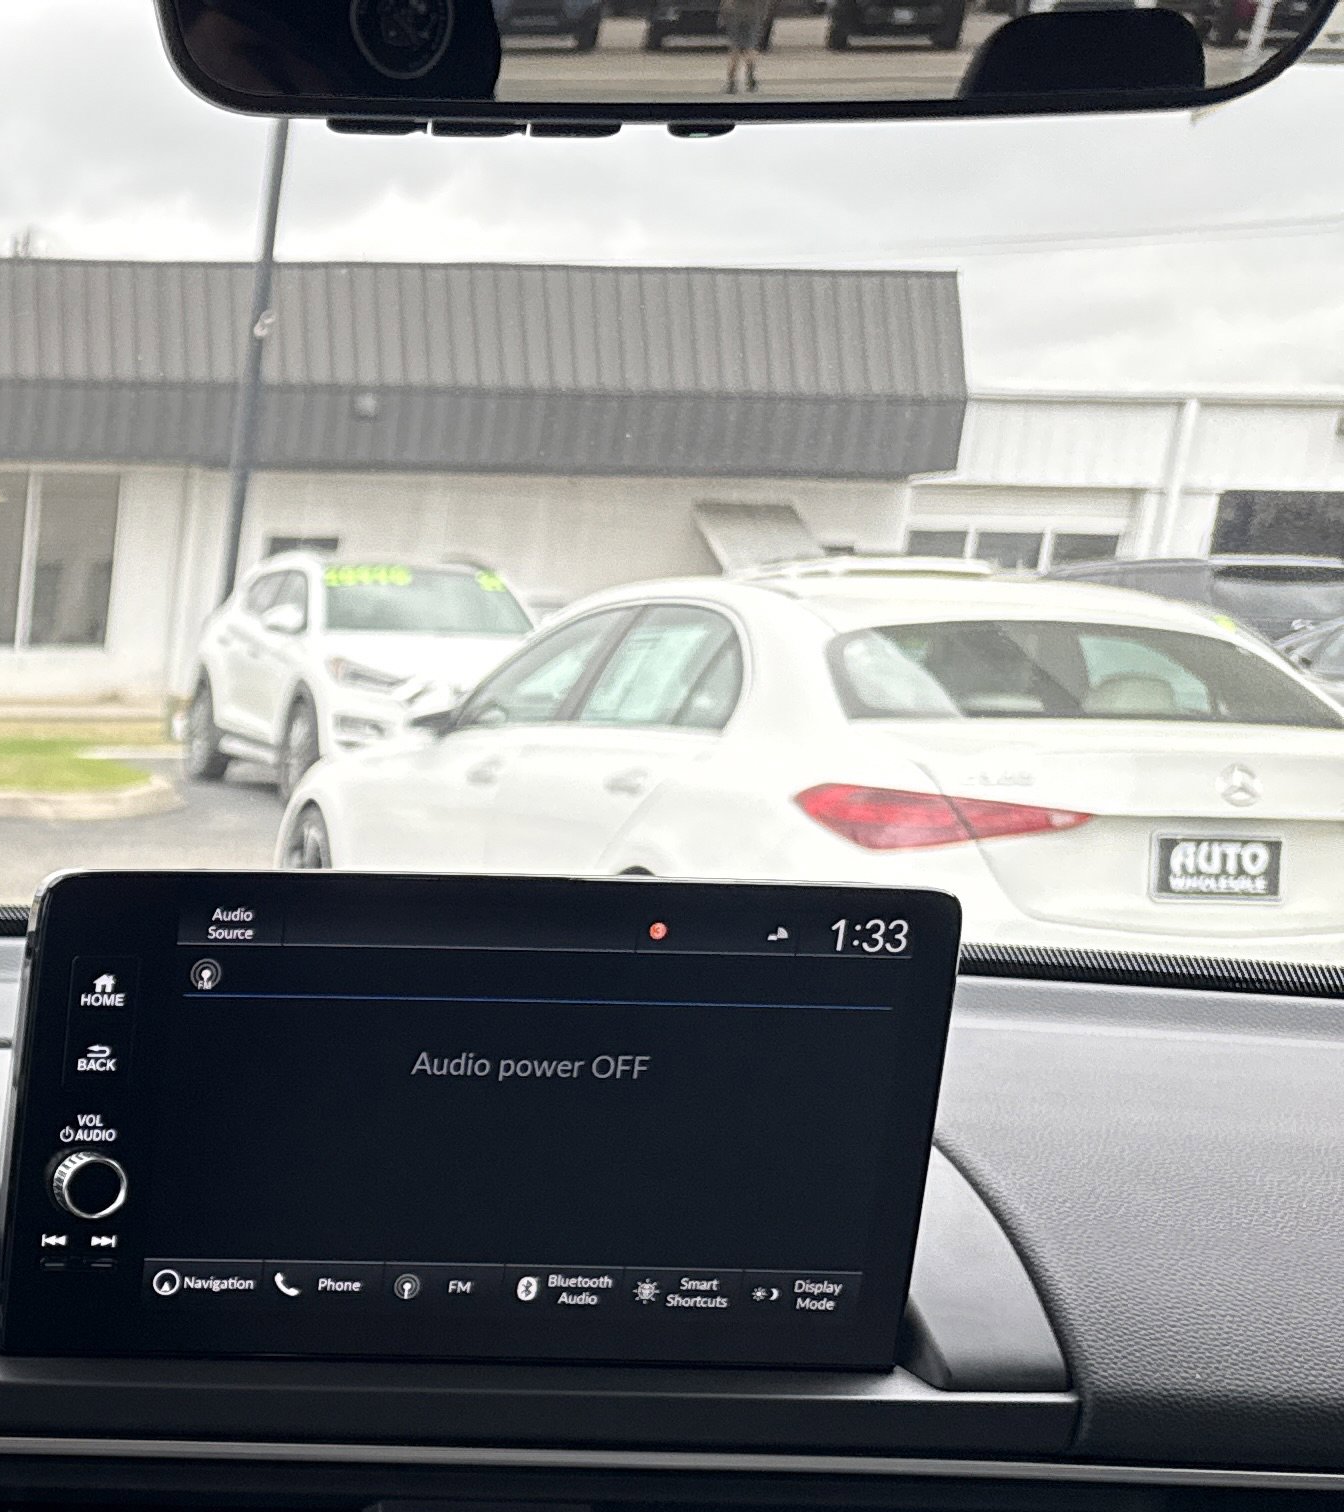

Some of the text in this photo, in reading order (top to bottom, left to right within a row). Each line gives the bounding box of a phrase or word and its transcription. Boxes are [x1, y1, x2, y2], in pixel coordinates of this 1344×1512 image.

[1170, 841, 1270, 876] AUTO
[212, 908, 254, 922] Audio
[207, 926, 254, 940] Source
[831, 919, 909, 953] 1:33
[80, 993, 125, 1007] HOME
[77, 1058, 117, 1072] BACK
[411, 1051, 650, 1081] Audio power OFF
[77, 1114, 103, 1127] VOL
[75, 1129, 116, 1141] AUDIO
[184, 1275, 255, 1291] Navigation
[318, 1278, 361, 1292] Phone
[448, 1281, 472, 1294] FM
[547, 1274, 613, 1289] Bluetooth
[680, 1278, 719, 1291] Smart
[793, 1281, 843, 1297] Display
[558, 1292, 598, 1305] Audio
[665, 1294, 728, 1308] Shortcuts
[796, 1298, 836, 1311] Mode
